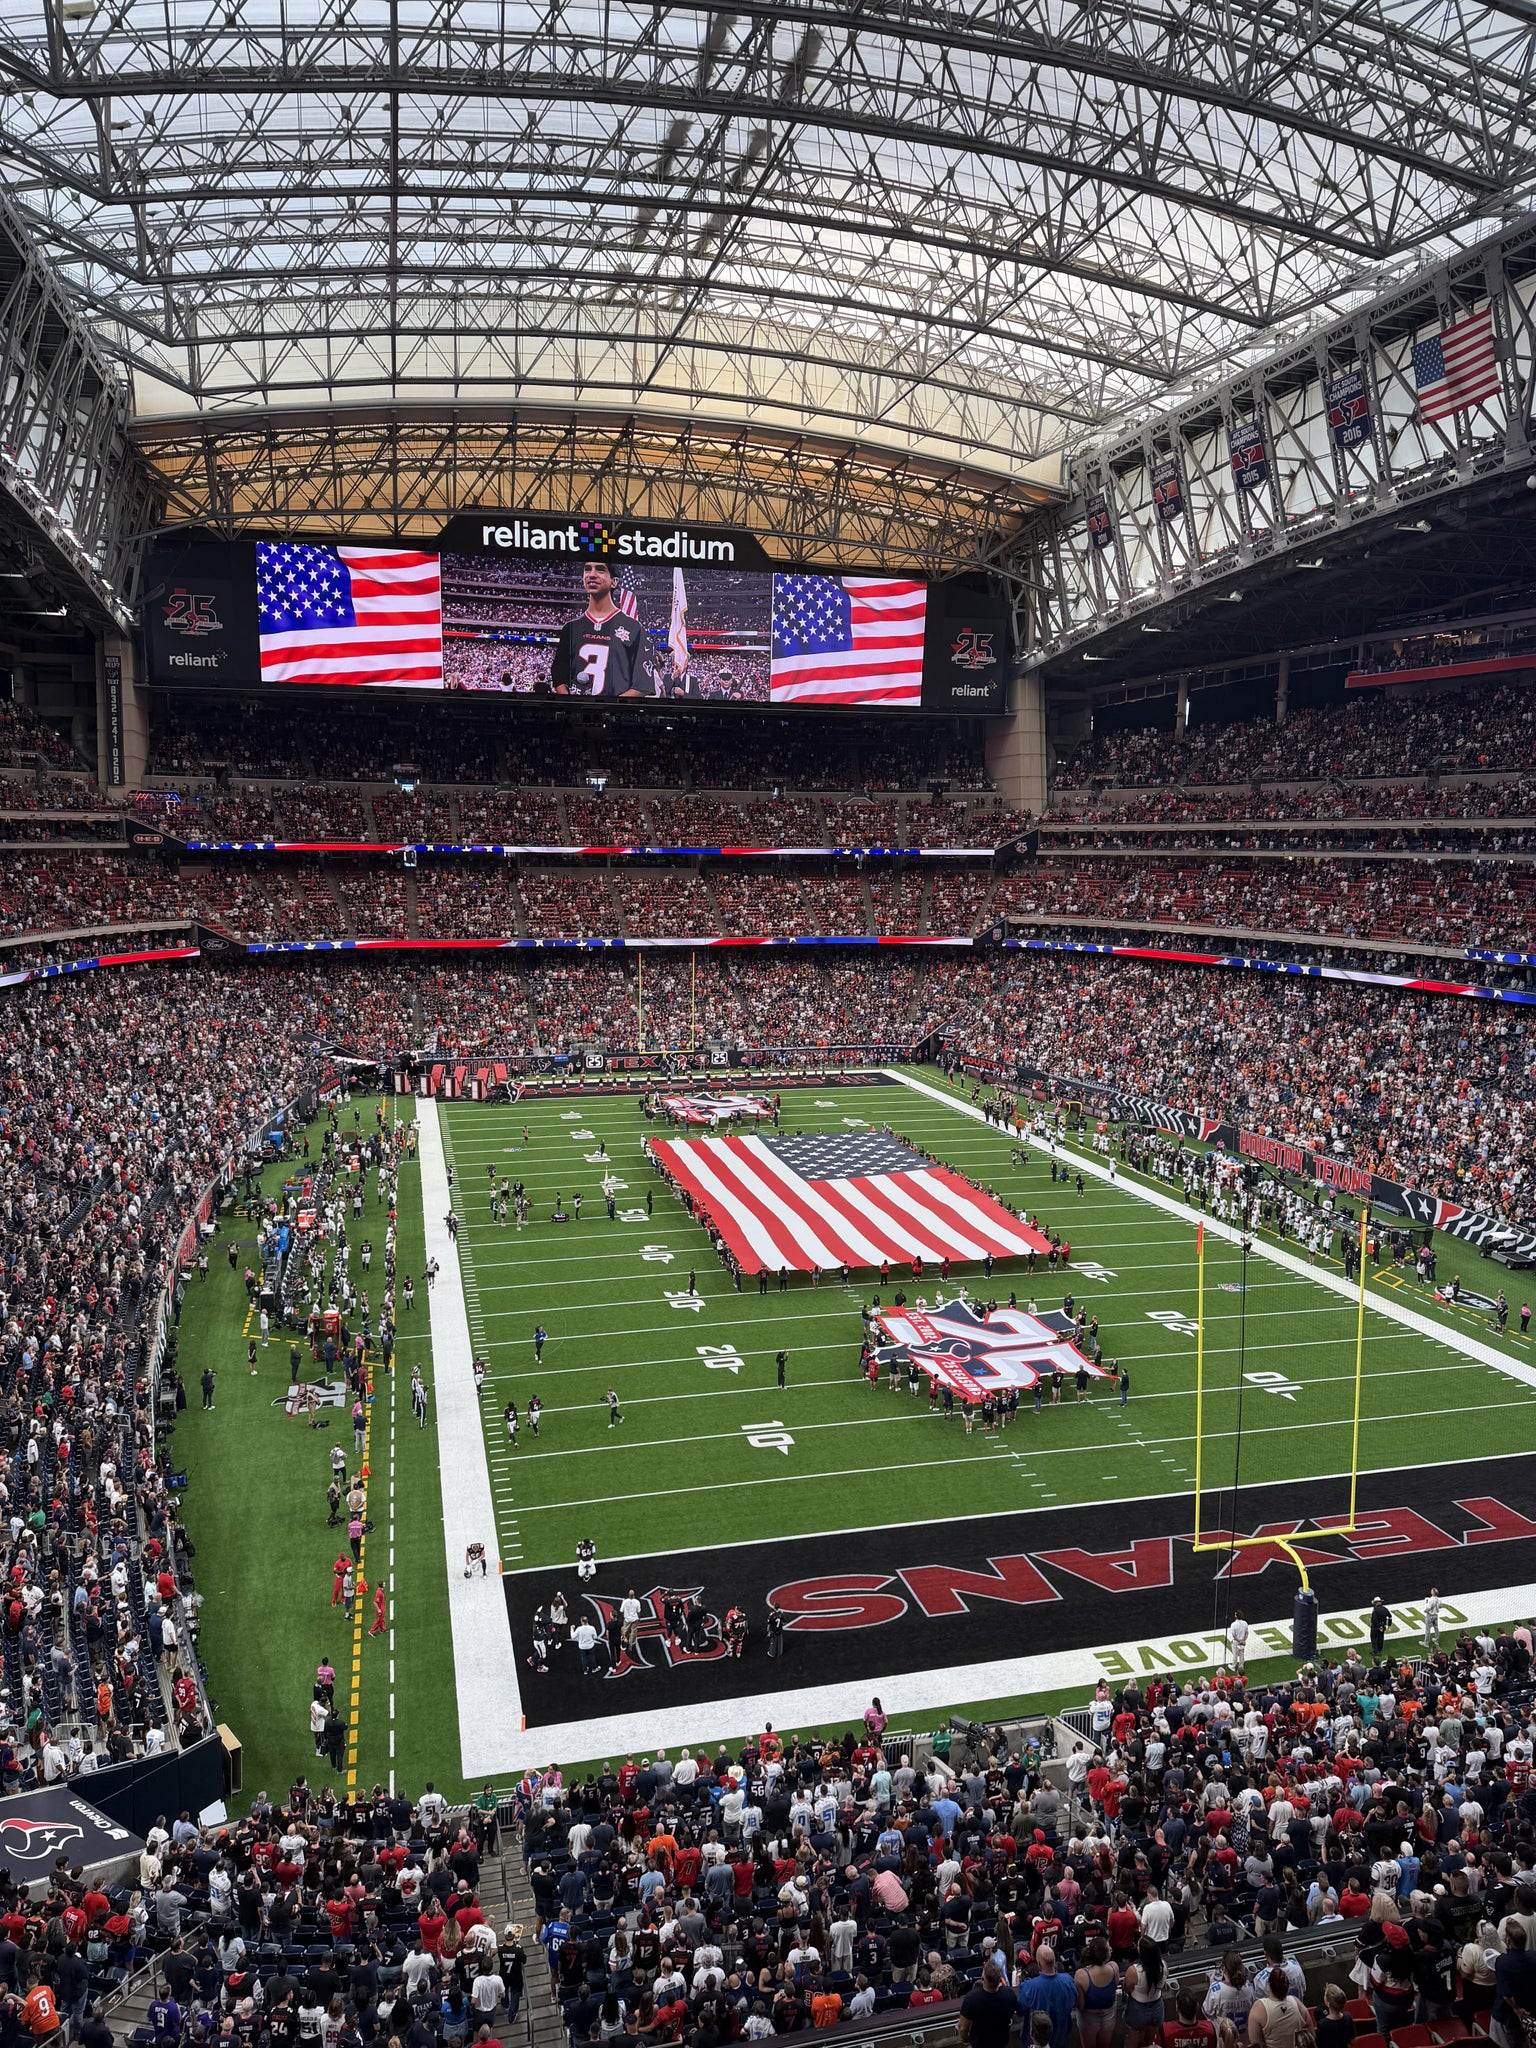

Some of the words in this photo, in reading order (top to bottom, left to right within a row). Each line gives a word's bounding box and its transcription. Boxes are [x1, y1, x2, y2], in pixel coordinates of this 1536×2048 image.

[1341, 375, 1358, 388] SOUTH
[1330, 381, 1362, 402] CHAMPIONS
[1231, 431, 1259, 448] CHAMPIONS
[1342, 425, 1362, 444] 2016
[1242, 469, 1259, 485] 2015
[482, 520, 580, 552] reliant
[617, 530, 735, 562] stadium
[169, 593, 217, 630] 25
[957, 633, 994, 665] 25
[169, 653, 218, 668] reliant
[579, 643, 610, 696] 3
[951, 684, 989, 697] reliant
[588, 1056, 601, 1068] 25
[713, 1052, 727, 1064] 25
[1239, 1131, 1304, 1176] HOUSTON
[1313, 1155, 1373, 1193] TEXANS
[1145, 1310, 1205, 1332] 20
[695, 1344, 746, 1369] 20
[1242, 1371, 1304, 1395] 10
[741, 1420, 796, 1448] 10
[765, 1495, 1536, 1631] TEXANS
[1093, 1633, 1236, 1676] LOVE
[1096, 1709, 1110, 1722] 24
[1420, 1748, 1426, 1759] 9
[751, 1785, 765, 1797] 56
[69, 1799, 113, 1830] Chevron
[669, 1825, 677, 1836] 7
[1406, 1829, 1414, 1840] 7
[862, 1834, 869, 1843] 7
[627, 1878, 639, 1889] 51
[1384, 1875, 1398, 1890] 30
[1009, 1890, 1017, 1902] 3
[742, 1929, 749, 1940] 3
[640, 1946, 654, 1958] 12
[870, 1951, 877, 1964] 3
[464, 1963, 480, 1979] 12
[505, 1961, 513, 1974] 7
[1440, 1970, 1452, 1991] 7
[39, 1998, 49, 2018] 9
[157, 2013, 165, 2028] 9
[271, 2022, 288, 2037] 24
